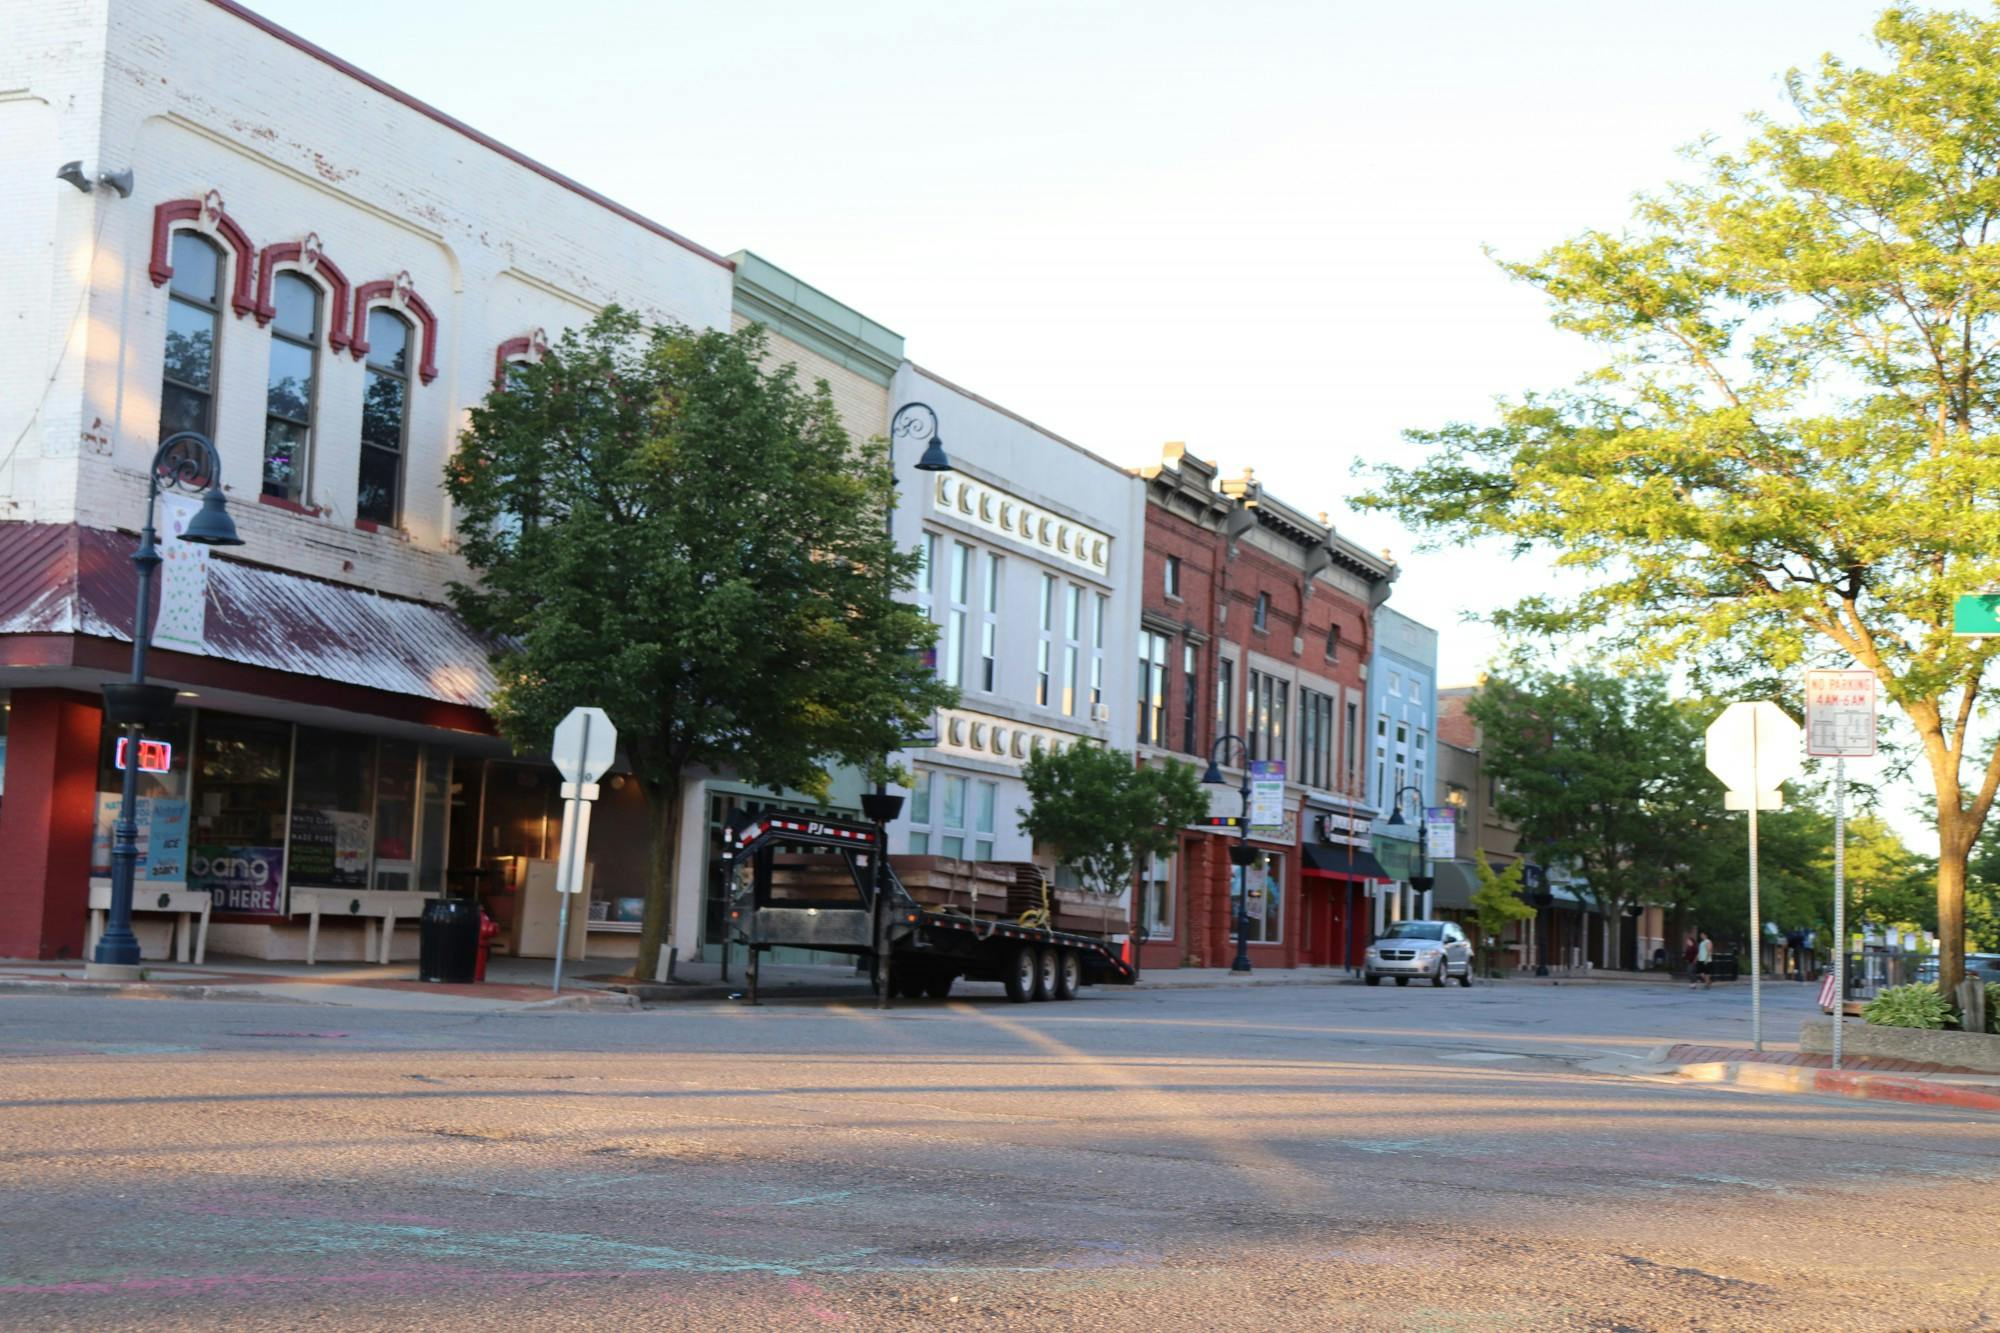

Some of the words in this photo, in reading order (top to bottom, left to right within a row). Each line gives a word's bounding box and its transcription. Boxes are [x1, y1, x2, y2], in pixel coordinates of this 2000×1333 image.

[1812, 678, 1824, 690] NO
[1829, 678, 1871, 691] PARKING
[808, 822, 824, 835] PJ
[191, 849, 269, 886] bang
[229, 889, 272, 909] HERE
